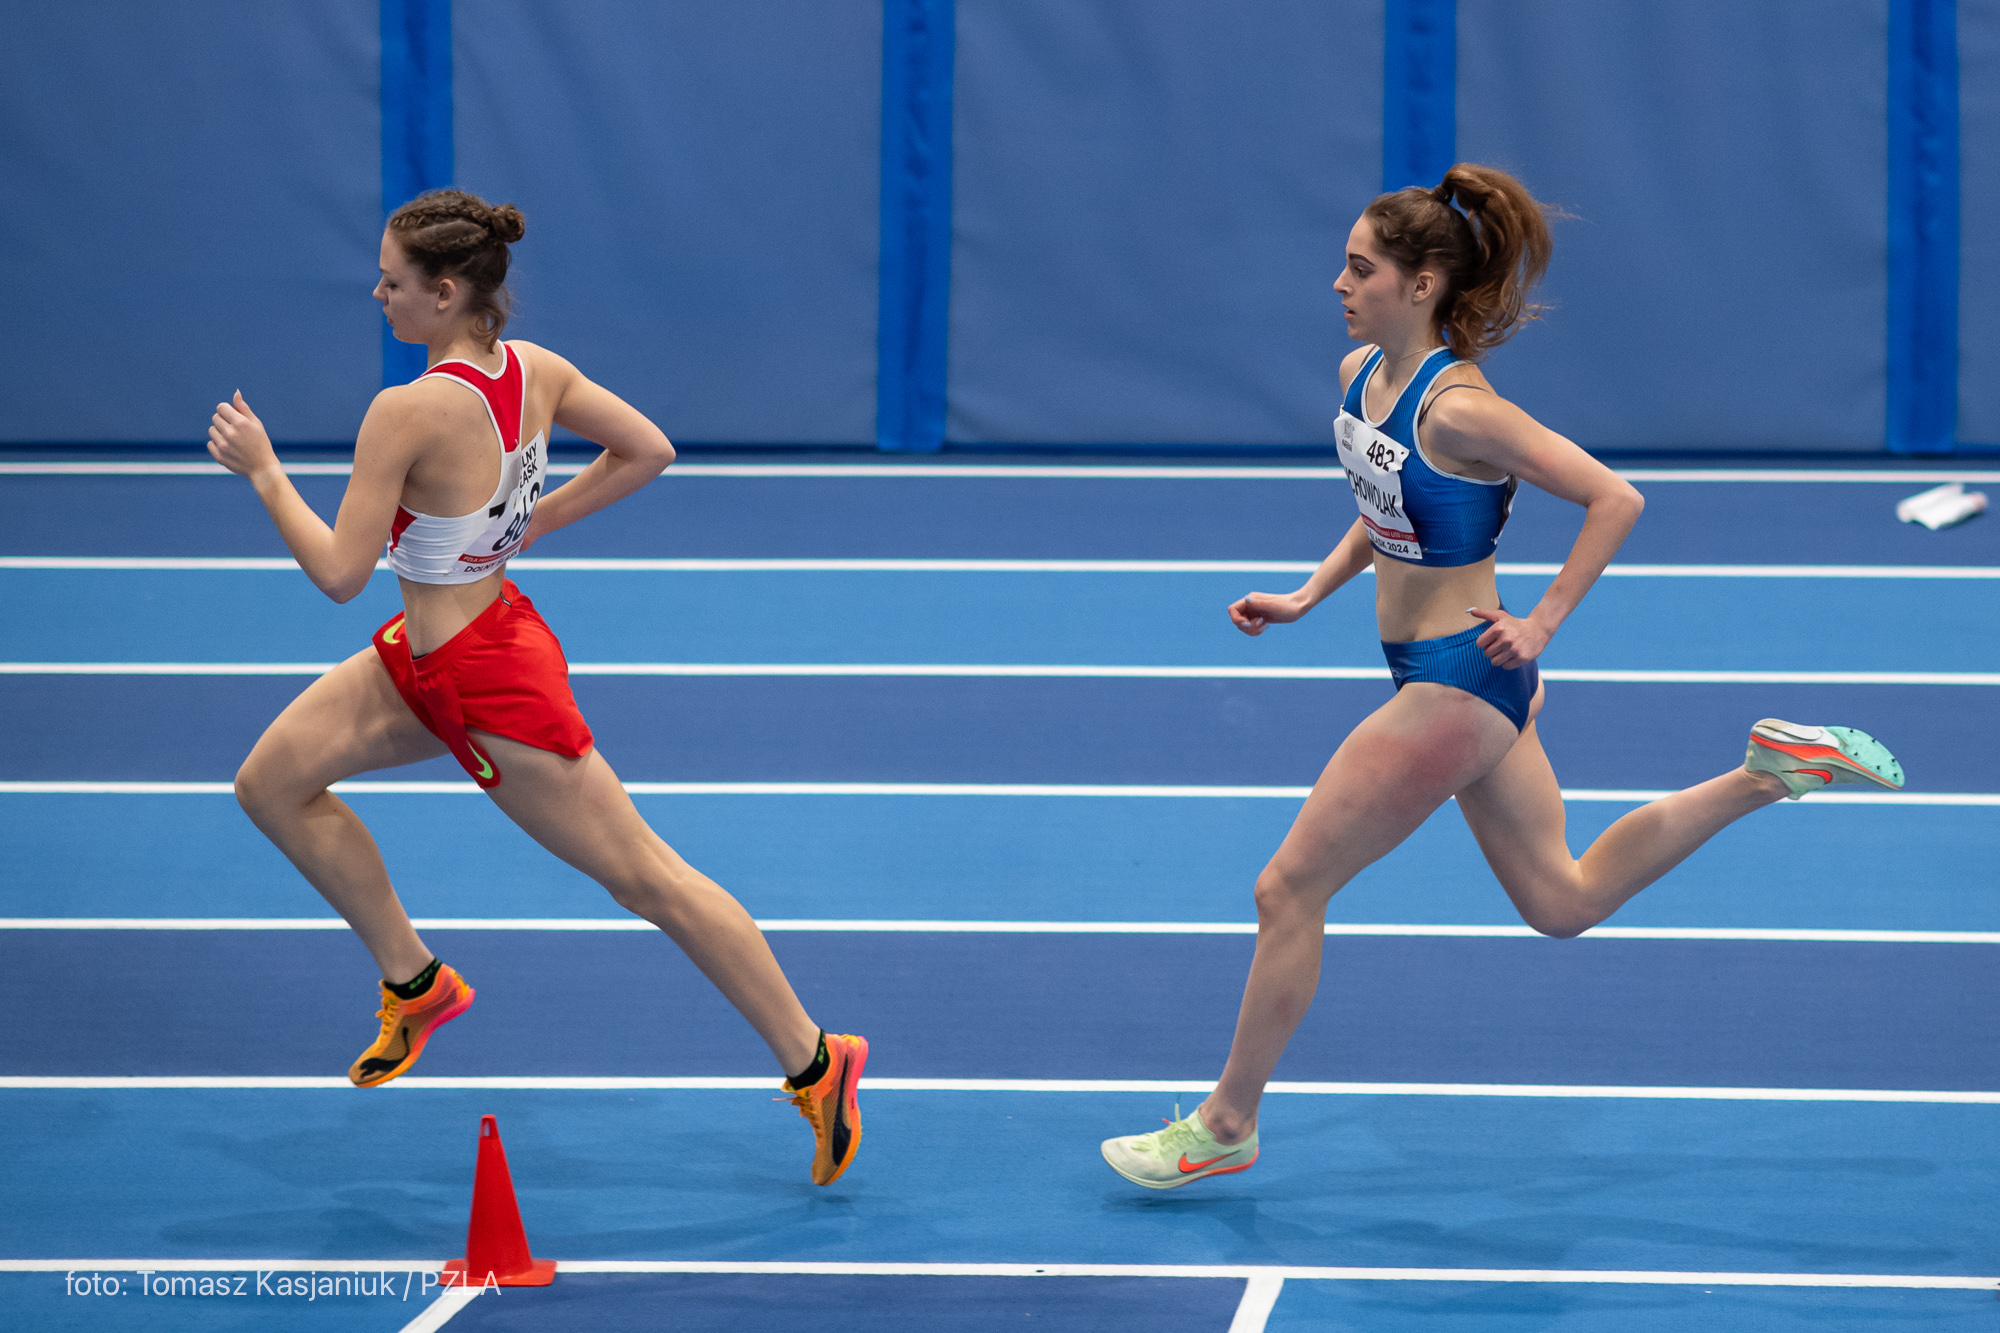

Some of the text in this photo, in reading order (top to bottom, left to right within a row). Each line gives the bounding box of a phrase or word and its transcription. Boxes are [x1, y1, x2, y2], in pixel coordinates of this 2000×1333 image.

[521, 442, 537, 468] LNY
[1366, 440, 1395, 472] 482
[1387, 542, 1410, 555] 2024
[463, 562, 497, 573] DOLNY
